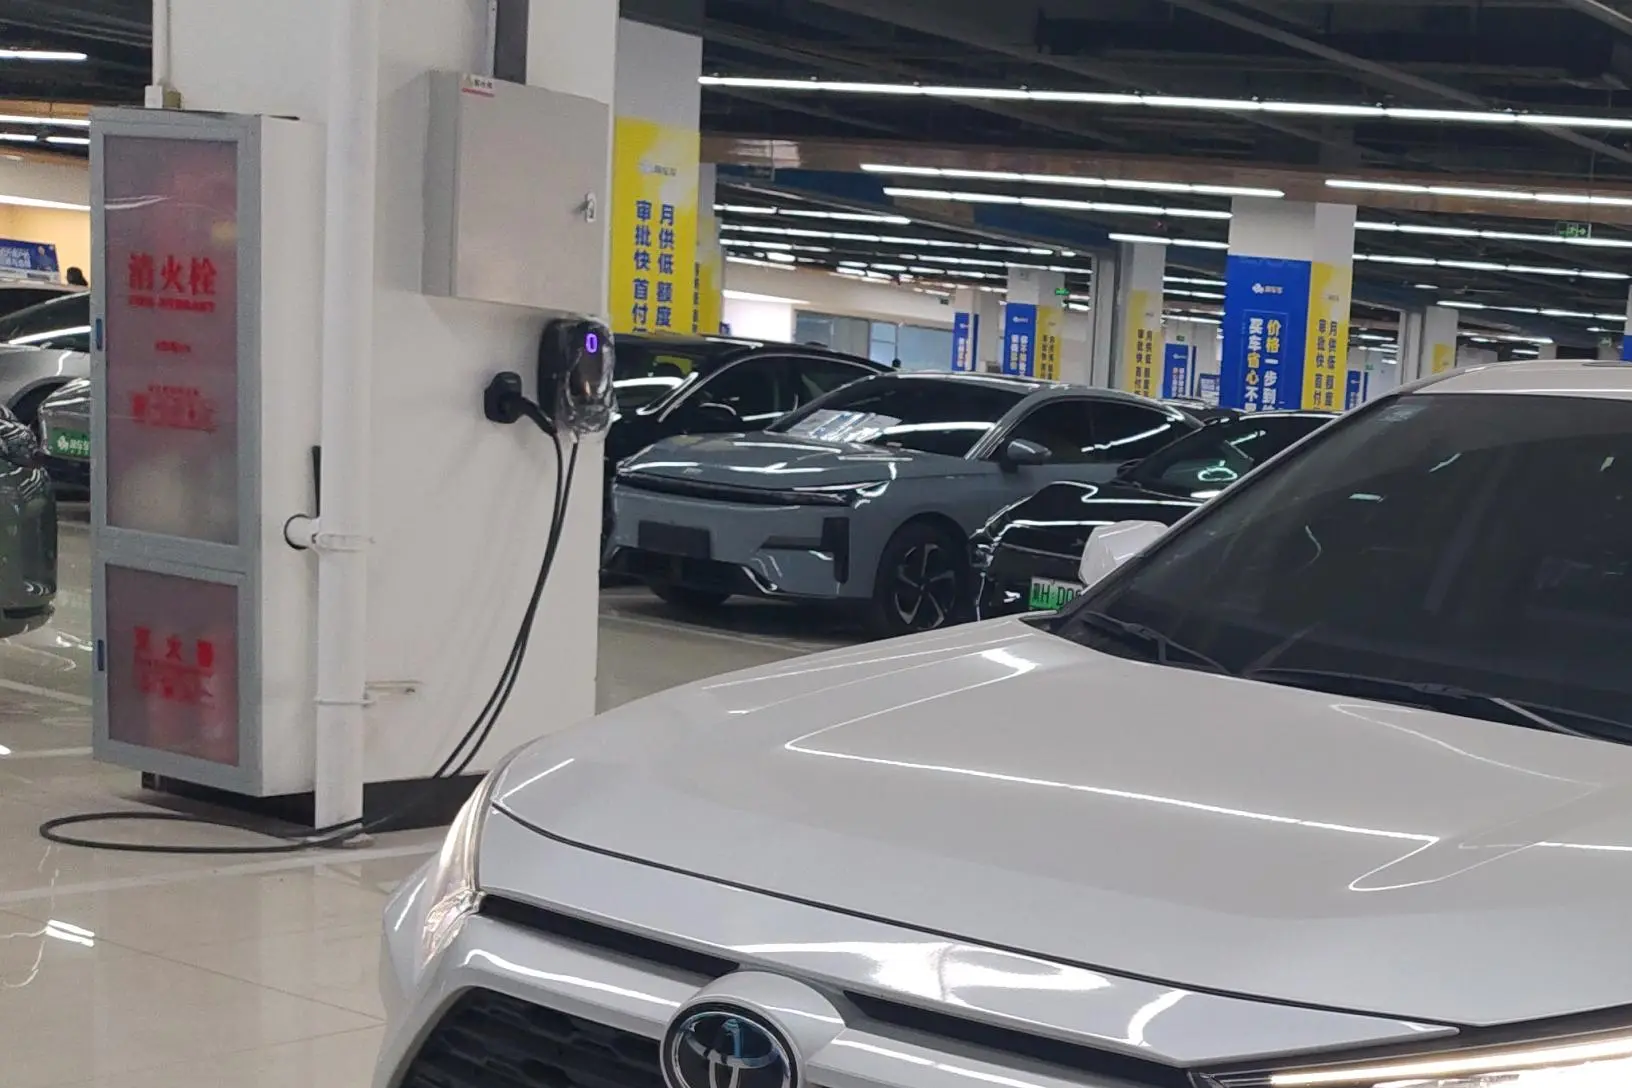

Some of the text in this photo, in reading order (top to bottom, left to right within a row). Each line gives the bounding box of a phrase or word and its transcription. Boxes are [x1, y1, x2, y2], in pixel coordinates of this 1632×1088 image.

[632, 200, 652, 332] 审批快首付
